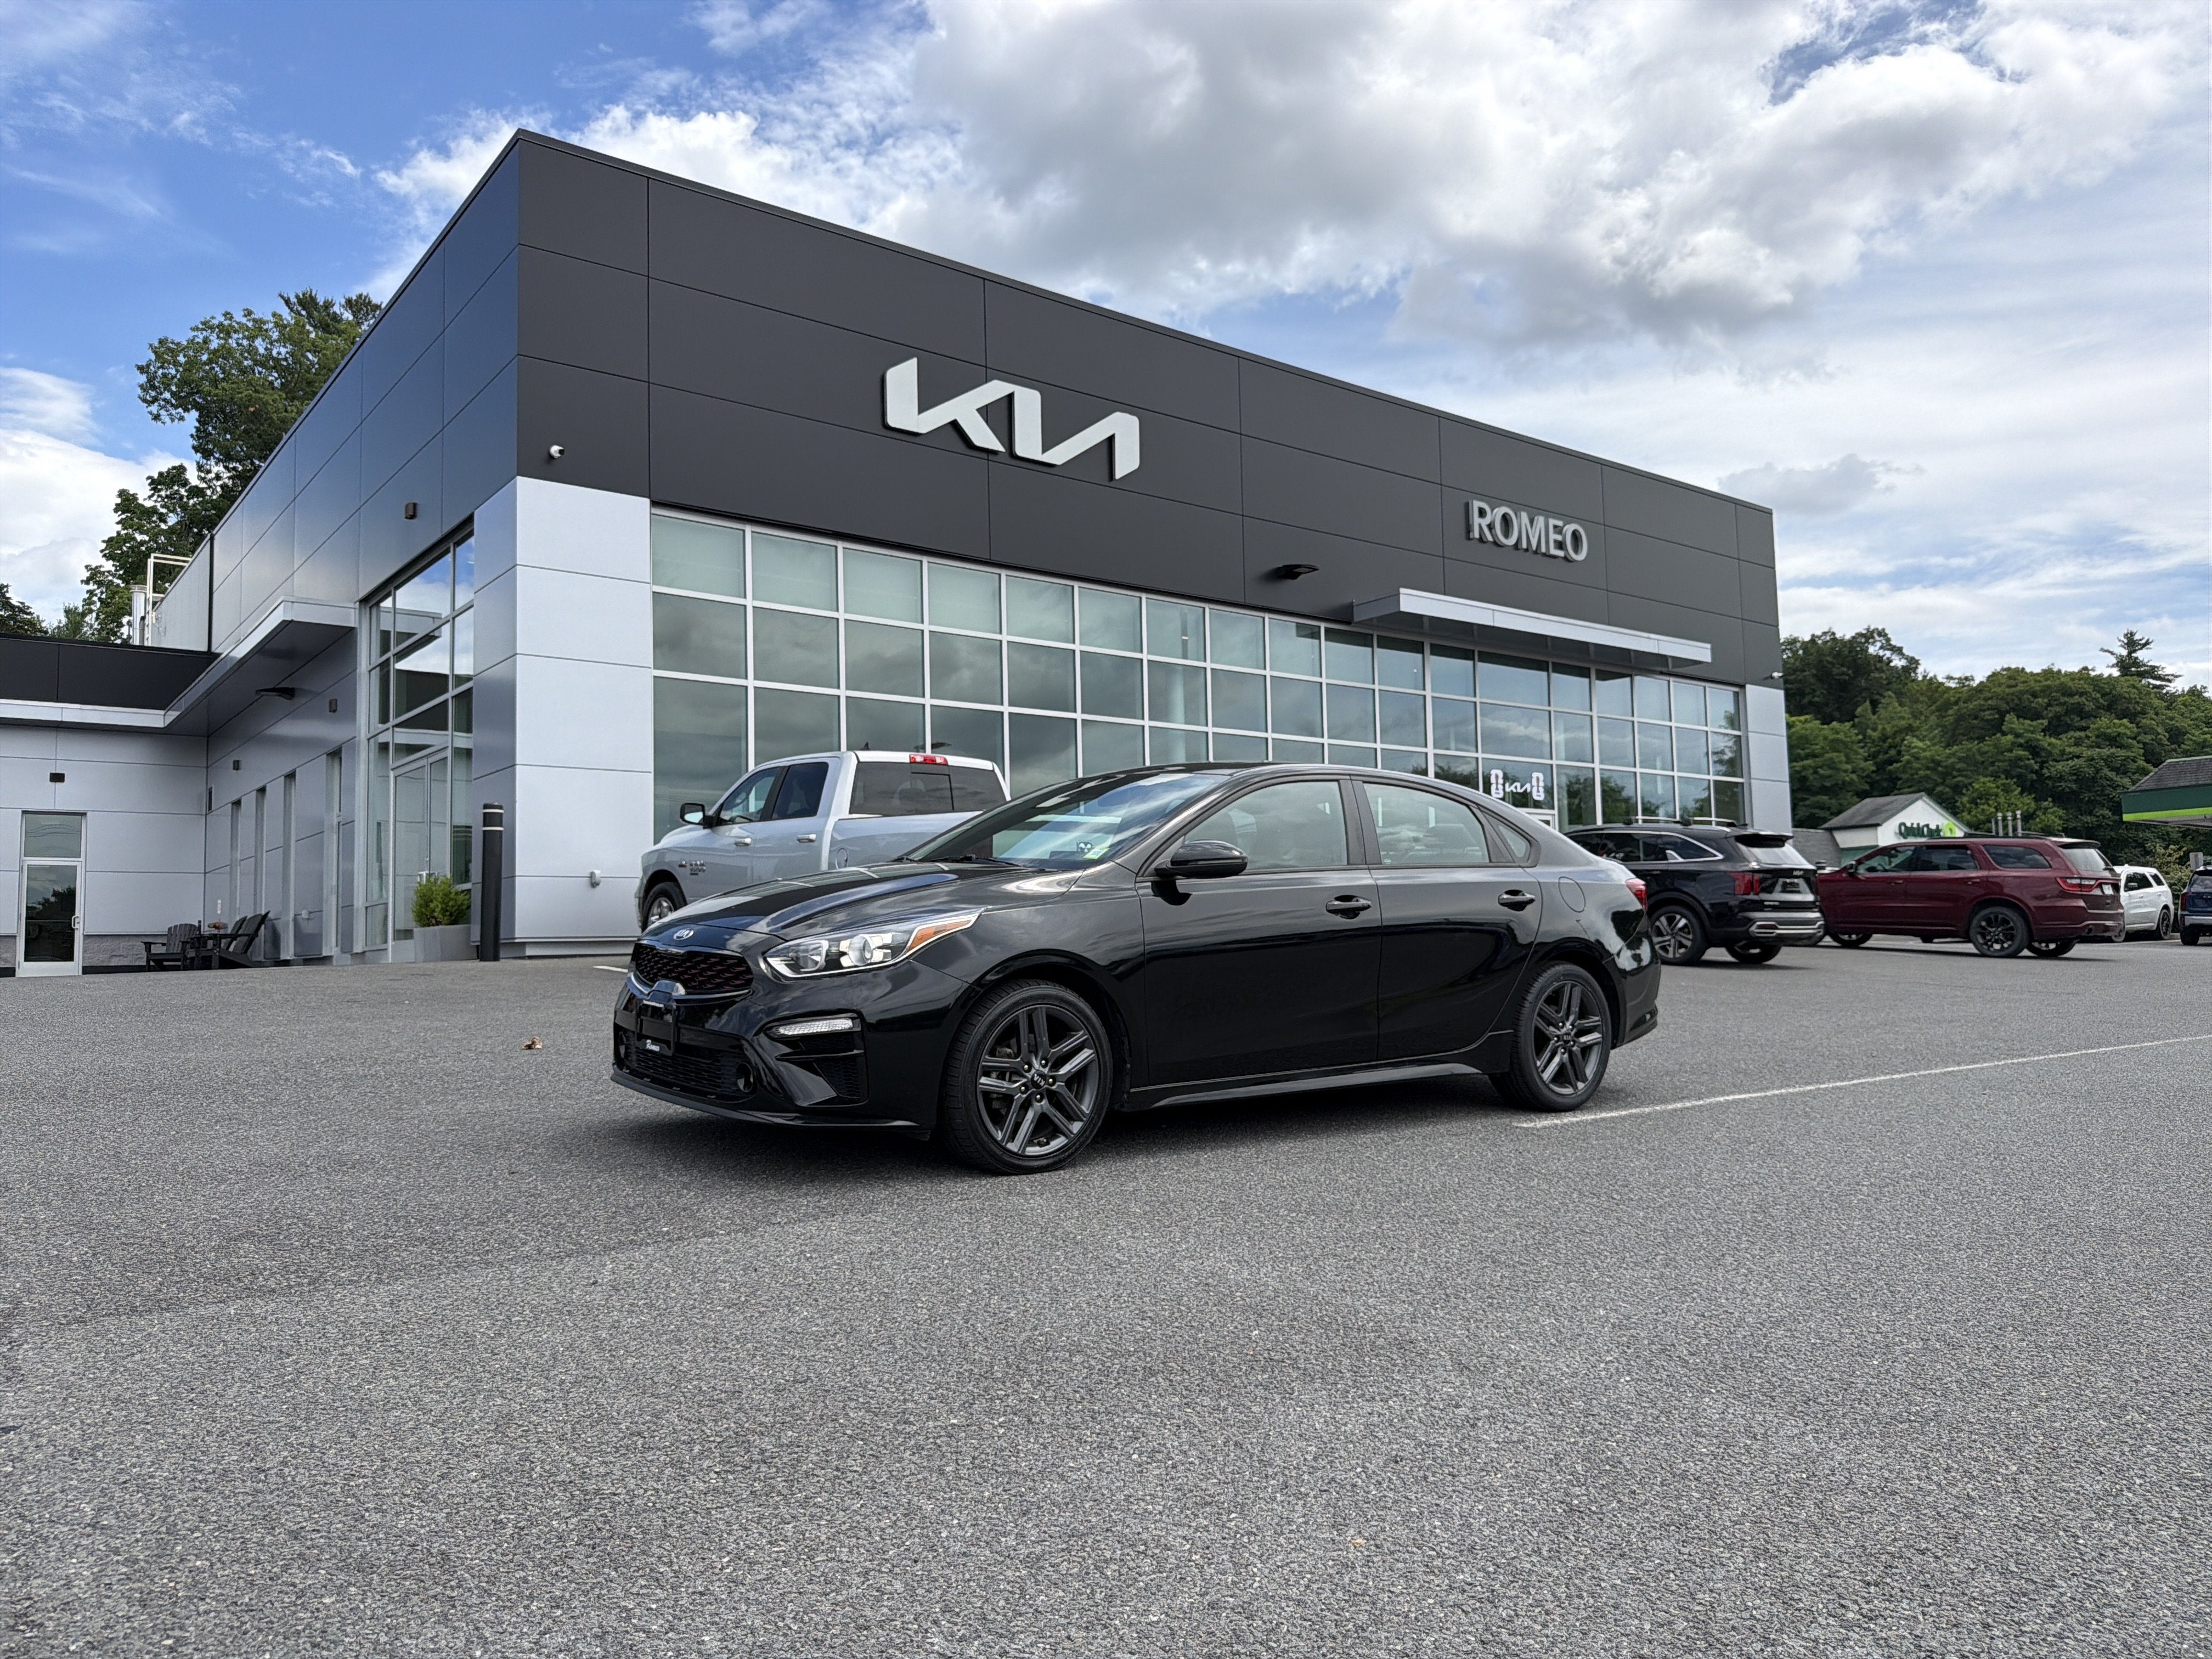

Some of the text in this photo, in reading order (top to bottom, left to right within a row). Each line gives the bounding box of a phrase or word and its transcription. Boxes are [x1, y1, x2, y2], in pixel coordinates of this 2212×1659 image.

[885, 357, 1140, 480] KIA
[1469, 500, 1588, 561] ROMEO
[1505, 782, 1531, 793] KIA
[1034, 1073, 1046, 1086] KIA
